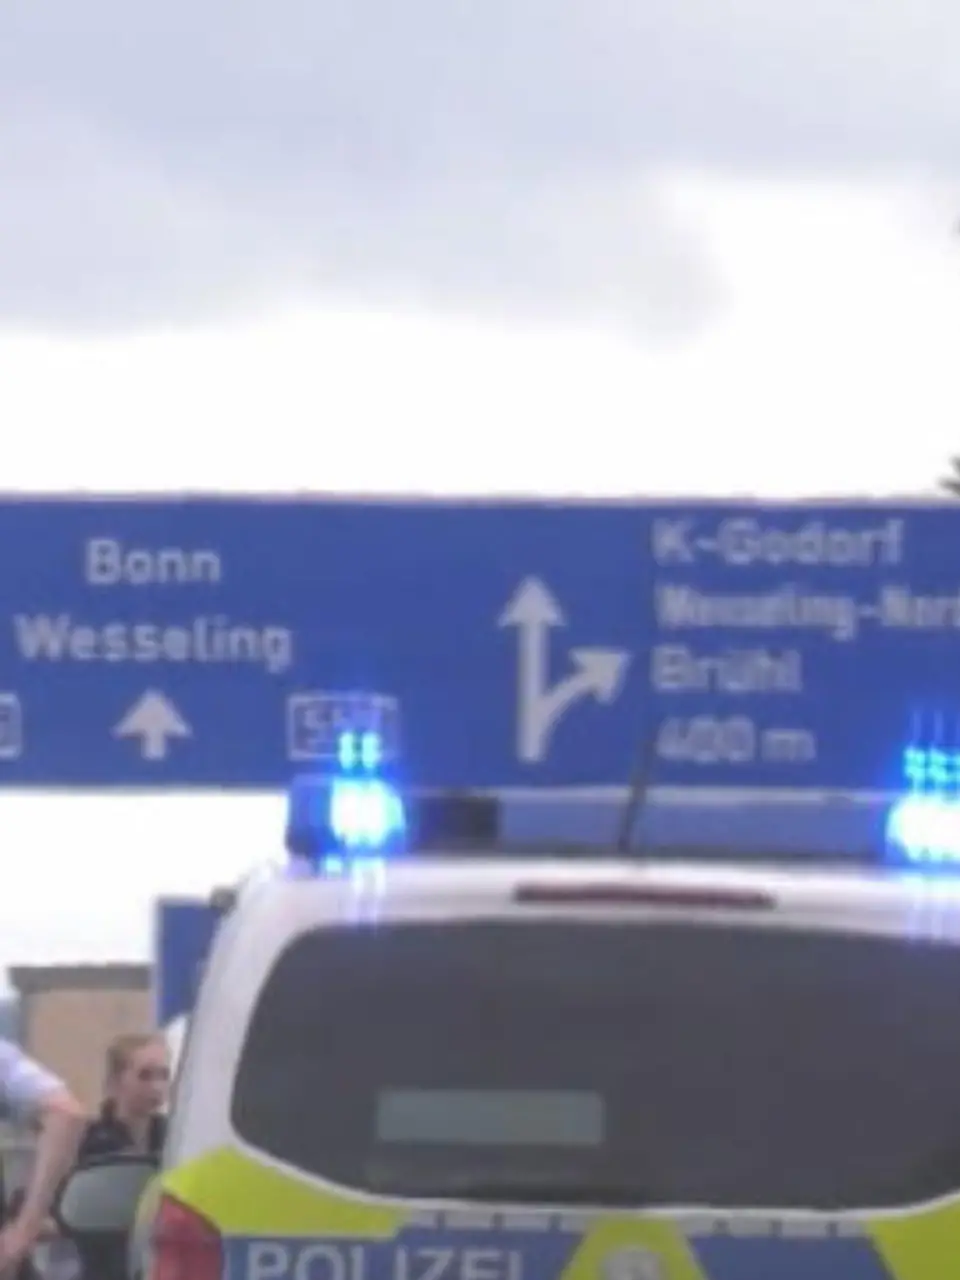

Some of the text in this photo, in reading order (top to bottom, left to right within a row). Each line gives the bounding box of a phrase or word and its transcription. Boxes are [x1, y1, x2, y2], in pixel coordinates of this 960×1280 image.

[86, 539, 221, 584] Bonn
[653, 520, 903, 564] K-Godorf
[15, 614, 291, 672] Wesseling
[653, 645, 801, 692] Brühl
[656, 717, 815, 762] 400 m
